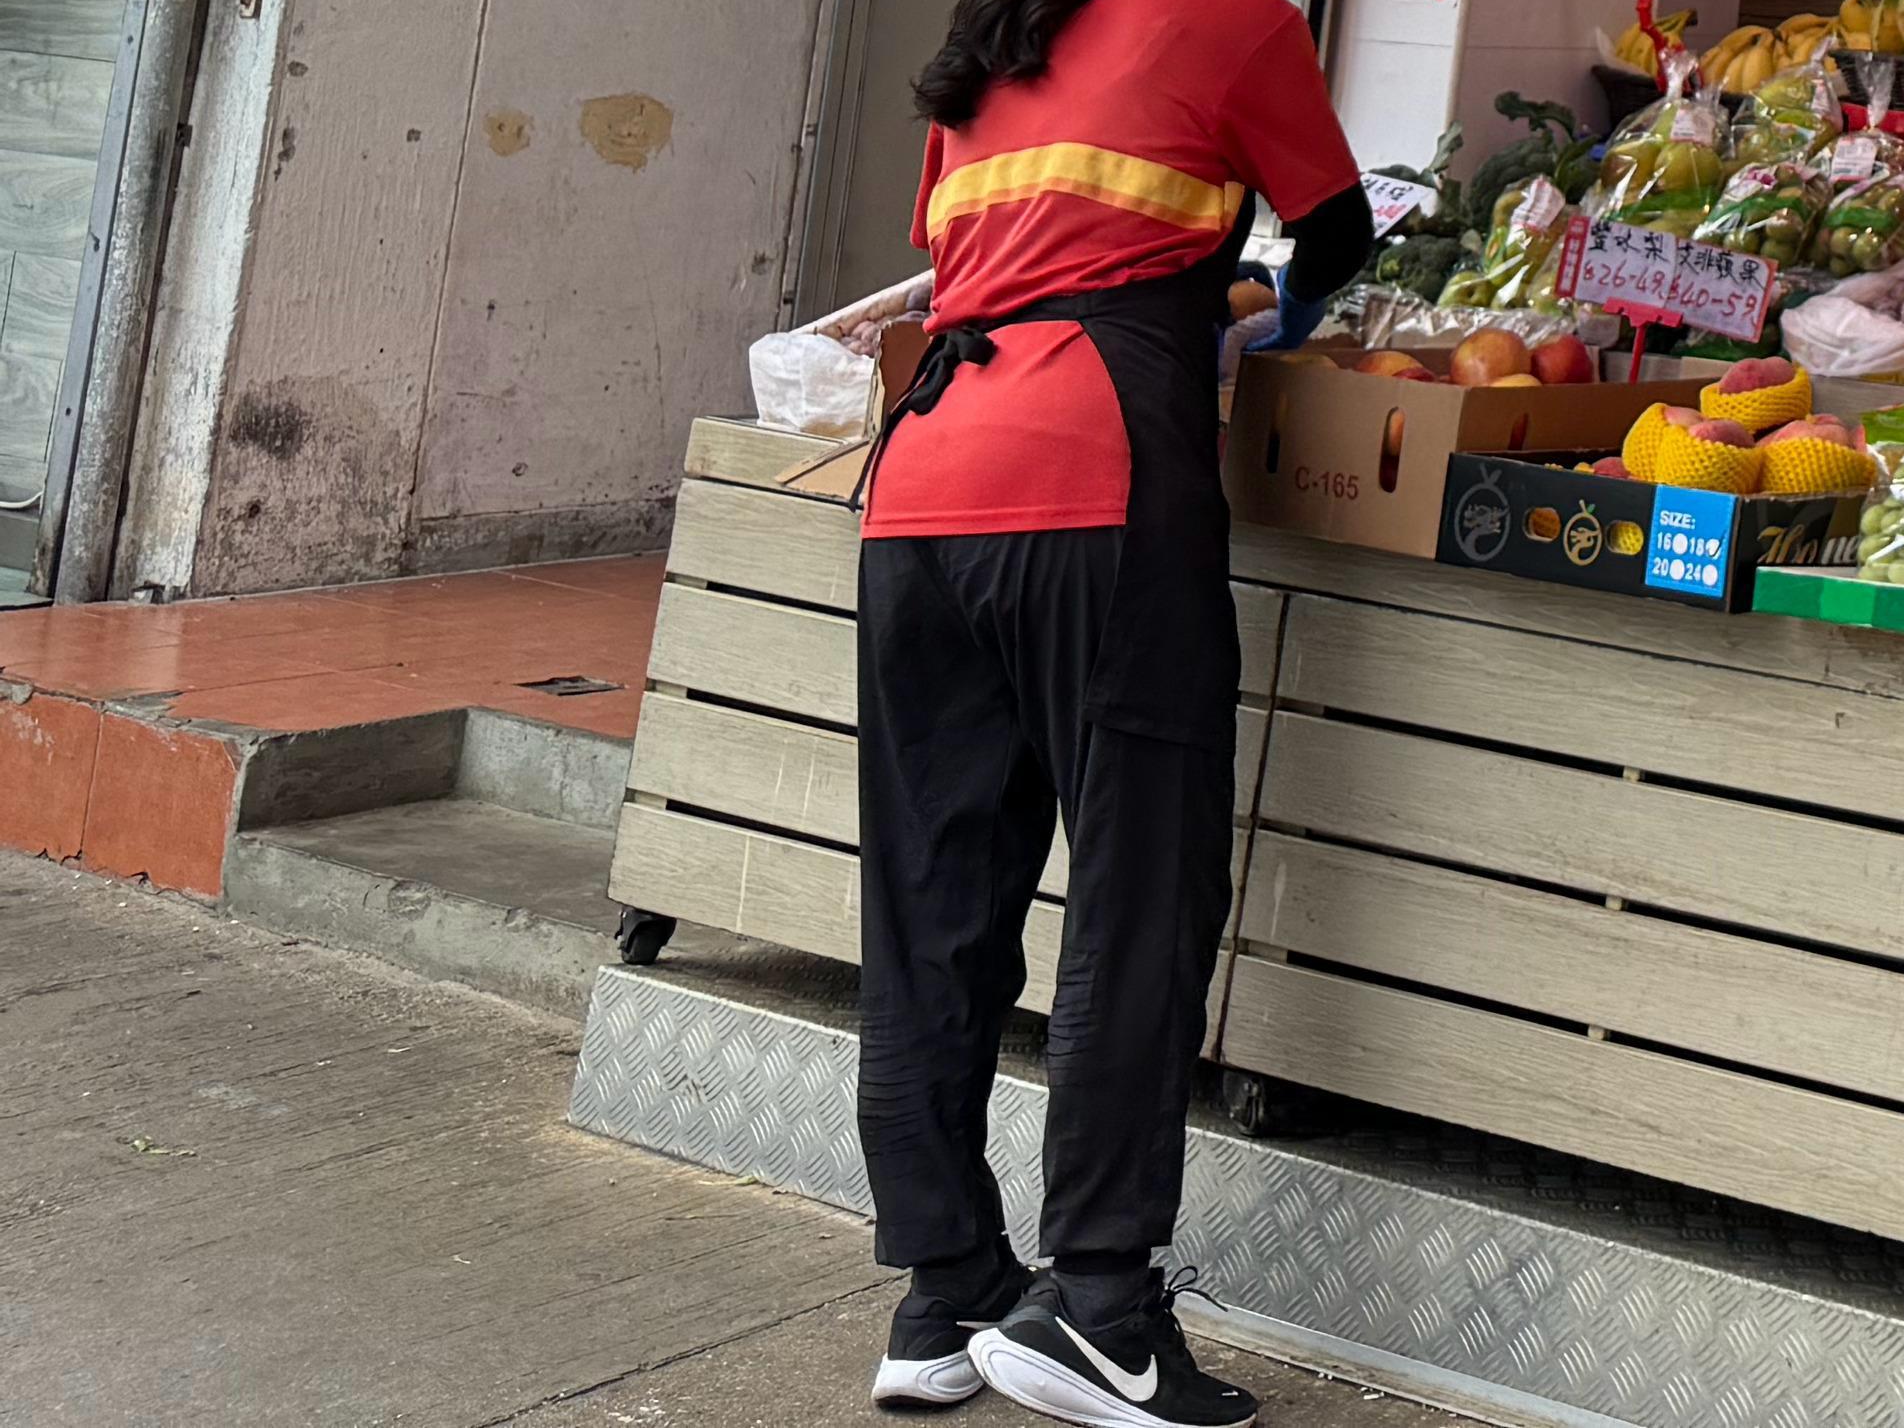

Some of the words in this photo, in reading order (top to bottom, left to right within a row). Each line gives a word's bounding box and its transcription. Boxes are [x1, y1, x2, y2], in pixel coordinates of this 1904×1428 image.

[1660, 509, 1697, 530] SIZE:
[1656, 531, 1673, 552] 16
[1689, 535, 1705, 557] 18
[1652, 556, 1670, 577] 20
[1685, 561, 1702, 582] 24
